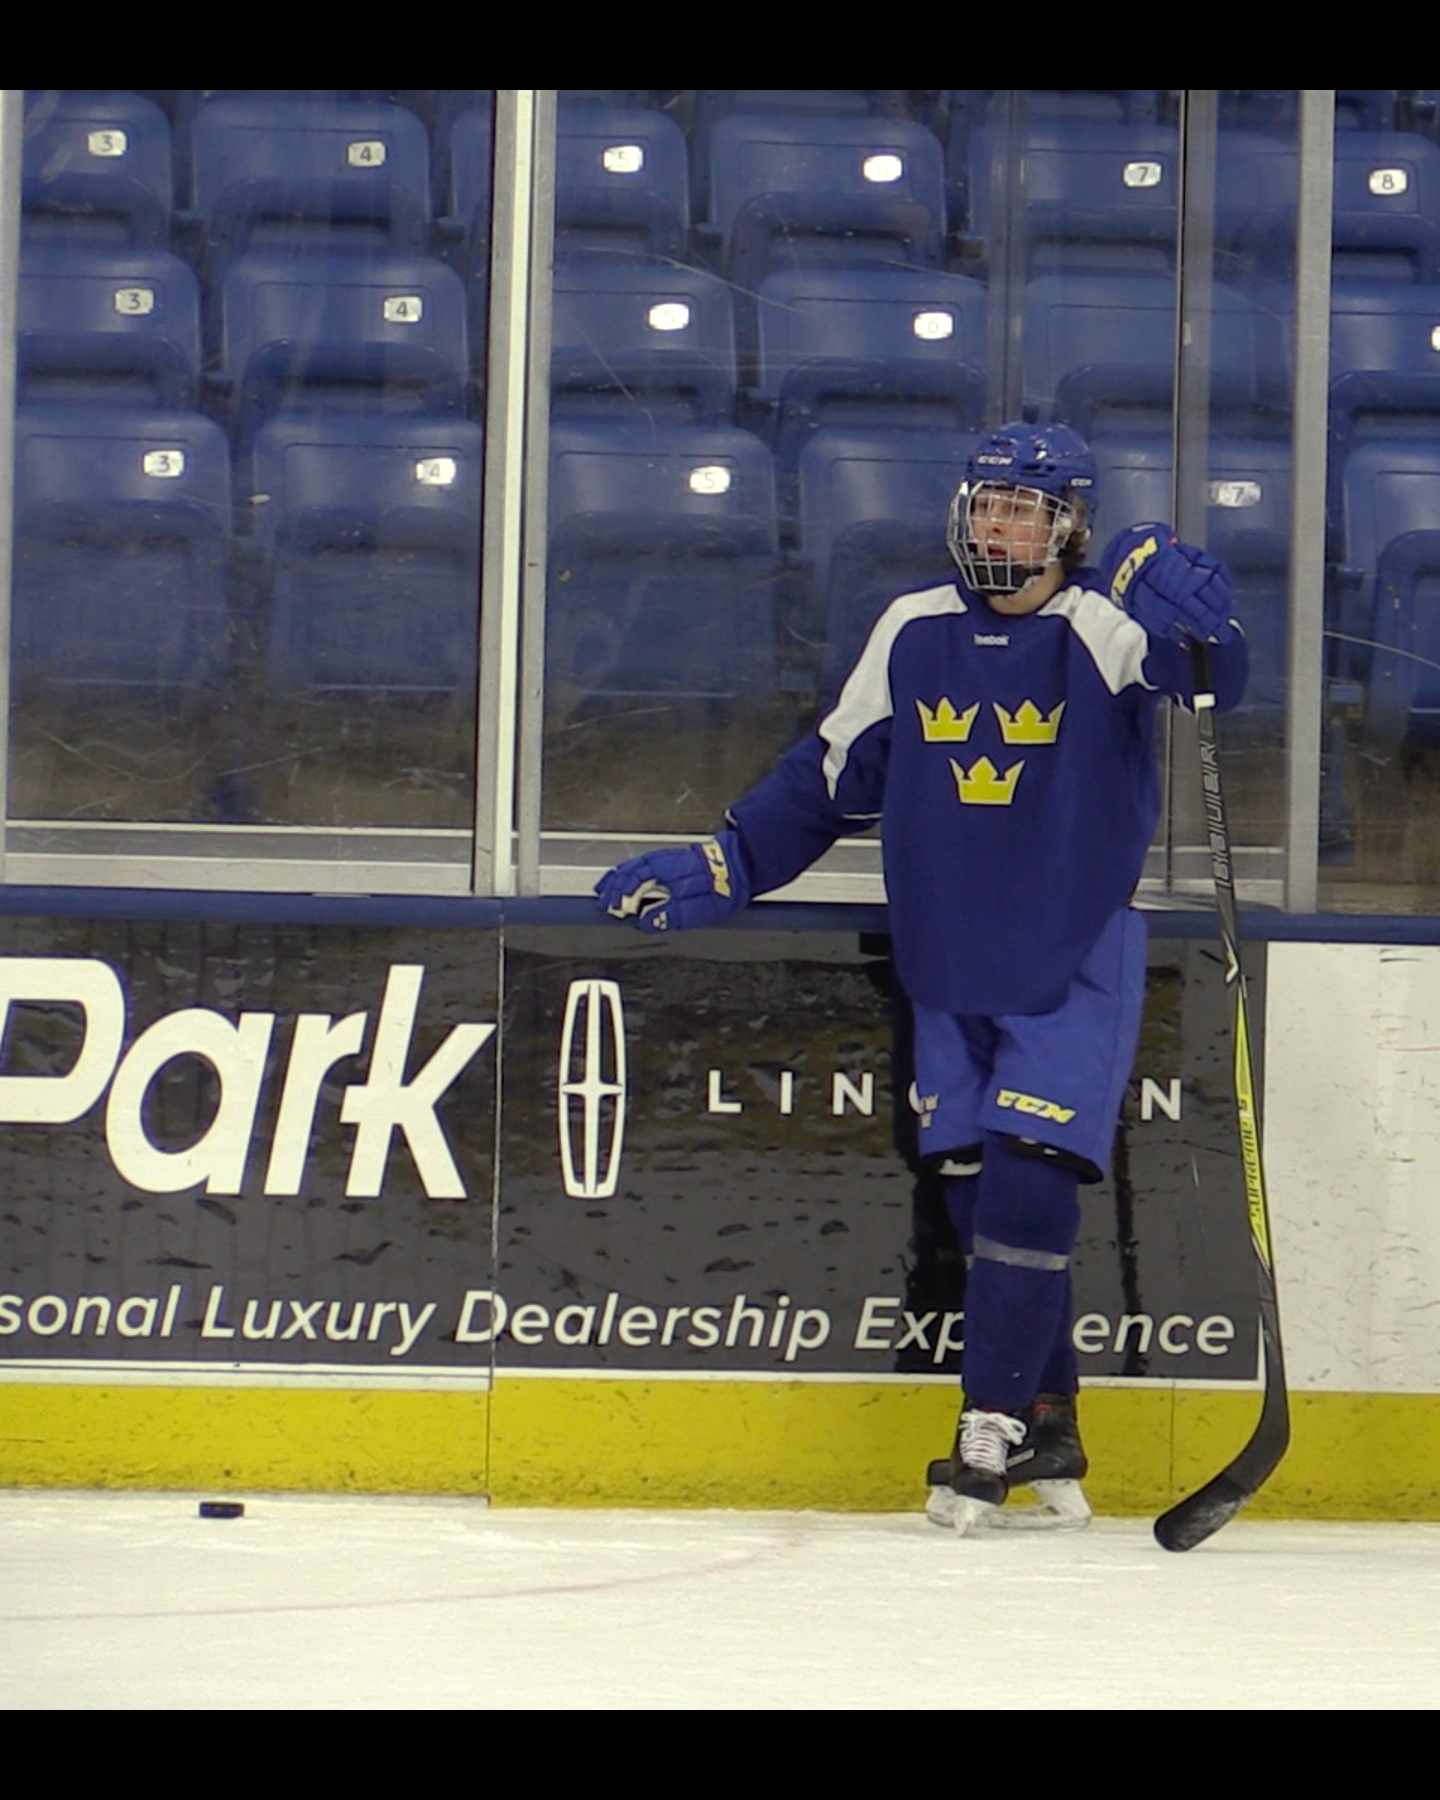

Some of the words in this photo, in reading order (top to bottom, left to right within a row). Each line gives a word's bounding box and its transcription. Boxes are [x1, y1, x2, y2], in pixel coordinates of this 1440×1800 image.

[102, 134, 114, 151] 3
[359, 145, 371, 162] 4
[618, 150, 629, 167] 5
[1137, 166, 1149, 182] 7
[1382, 173, 1395, 190] 8
[128, 293, 141, 310] 3
[395, 301, 409, 317] 4
[927, 317, 939, 333] 6
[158, 455, 170, 472] 3
[429, 462, 441, 479] 4
[704, 472, 716, 489] 5
[1231, 486, 1245, 502] 7
[0, 956, 497, 1199] Park
[708, 1070, 1181, 1122] LINN
[997, 1089, 1077, 1125] CCM
[0, 1285, 181, 1338] sonal
[201, 1285, 437, 1356] Luxury
[455, 1290, 831, 1362] Dealership
[853, 1296, 1236, 1364] Expence
